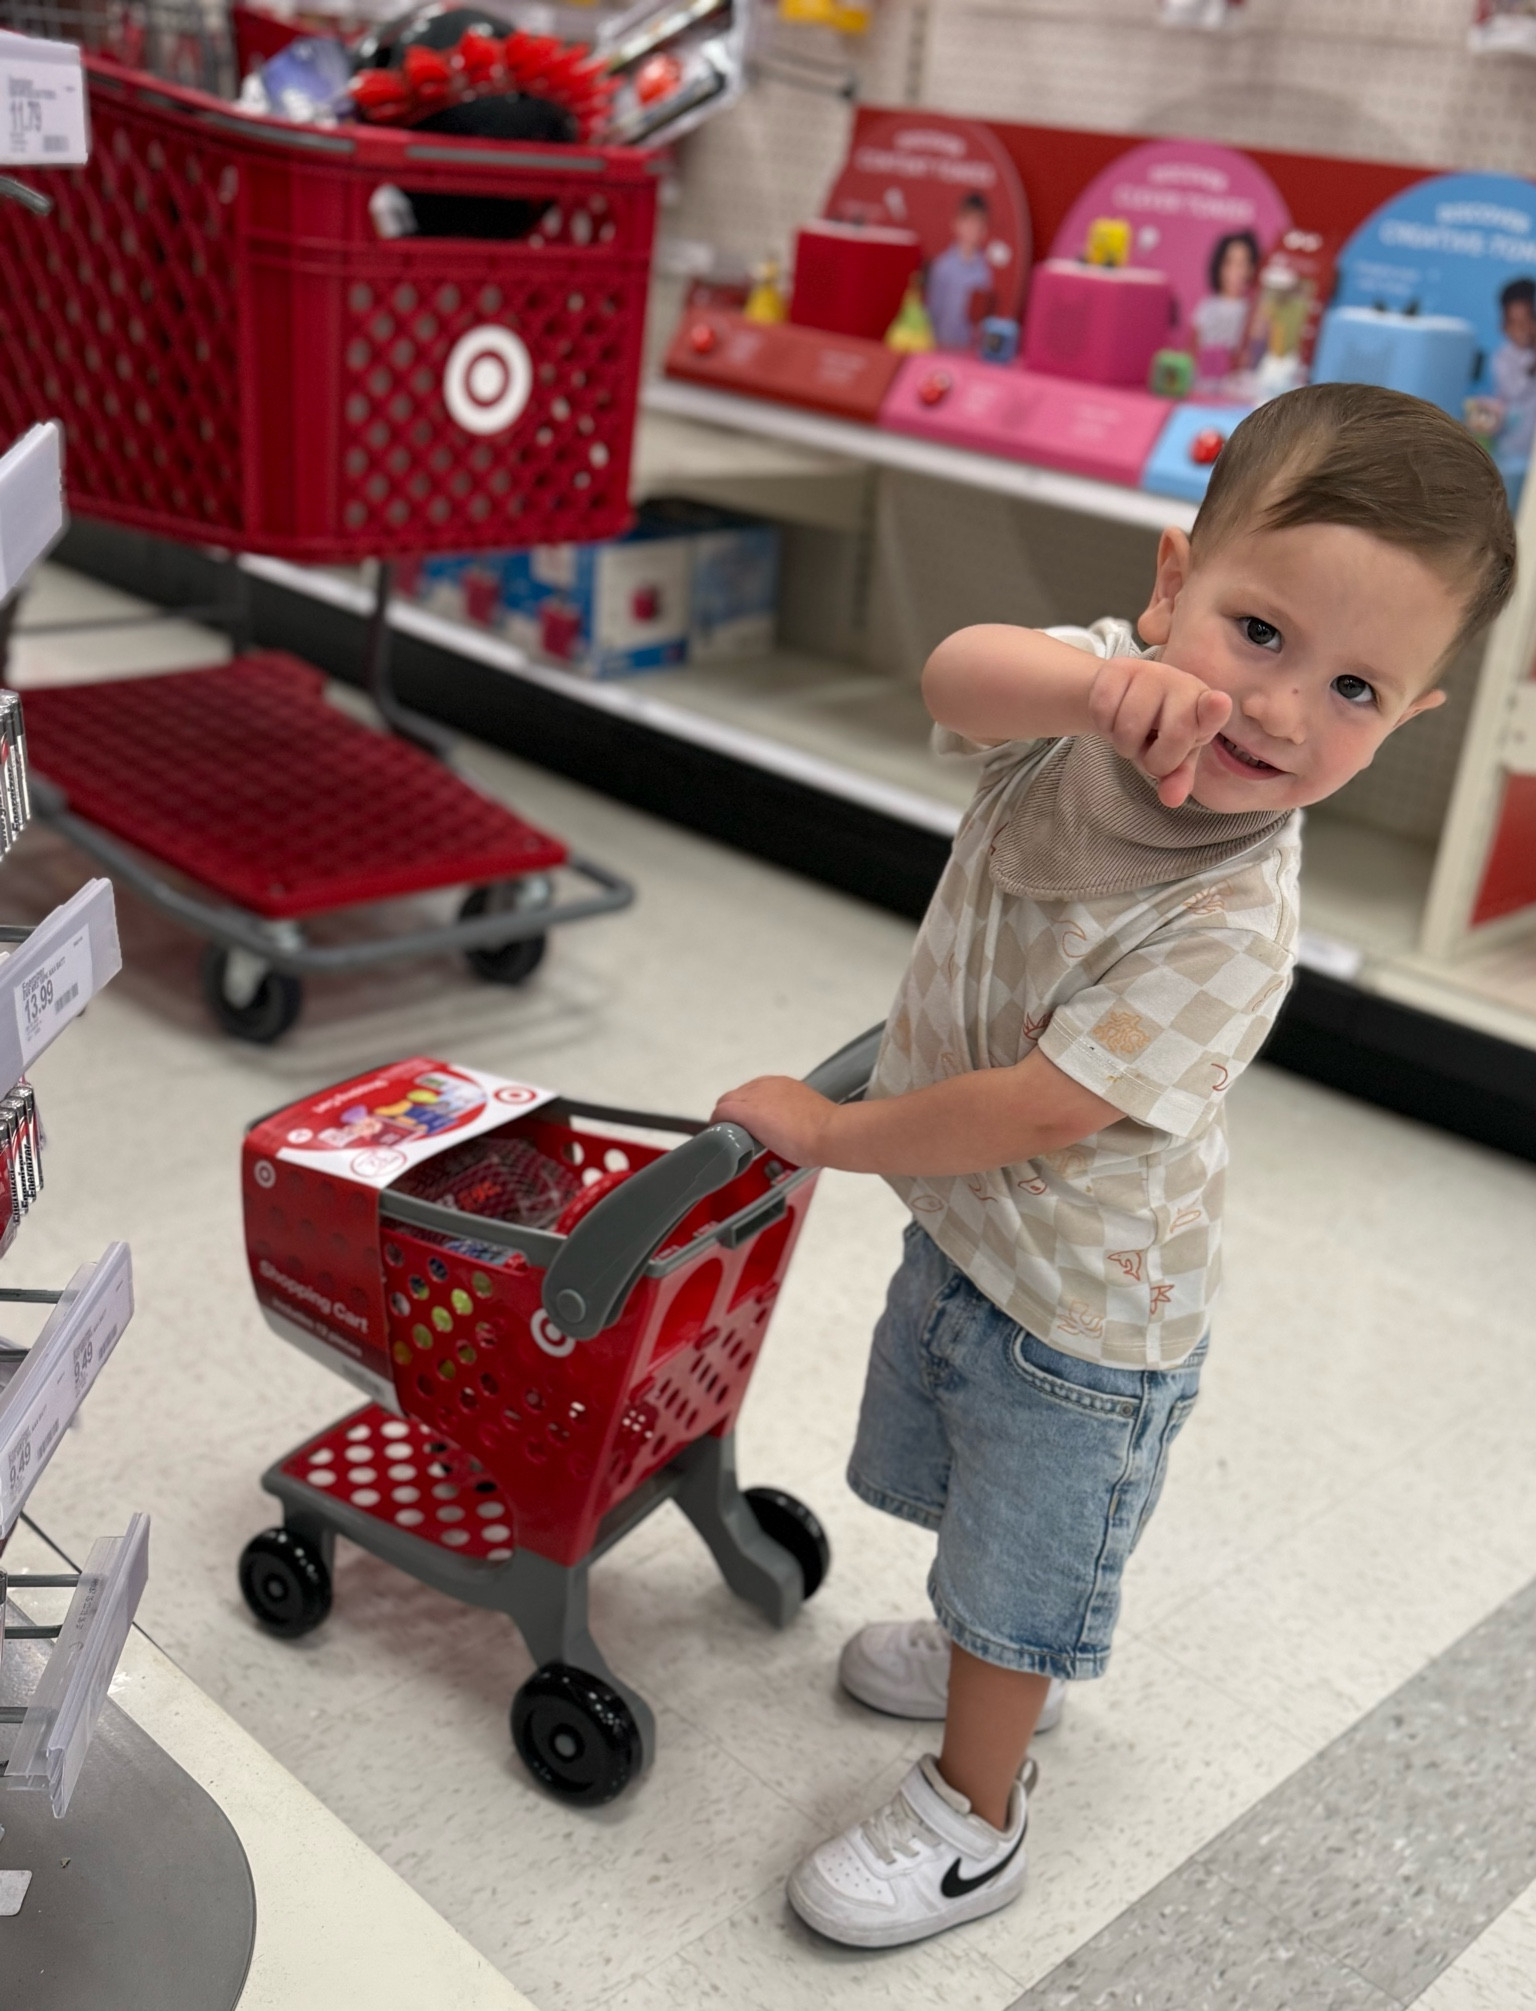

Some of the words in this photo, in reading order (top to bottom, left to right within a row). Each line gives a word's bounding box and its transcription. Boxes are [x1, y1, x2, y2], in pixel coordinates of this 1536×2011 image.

[25, 979, 54, 1023] 13.99
[24, 1143, 36, 1198] Energizer
[259, 1259, 332, 1316] Shopping
[333, 1302, 368, 1334] Cart
[74, 1341, 93, 1384] 9.49
[9, 1442, 31, 1490] 9.49
